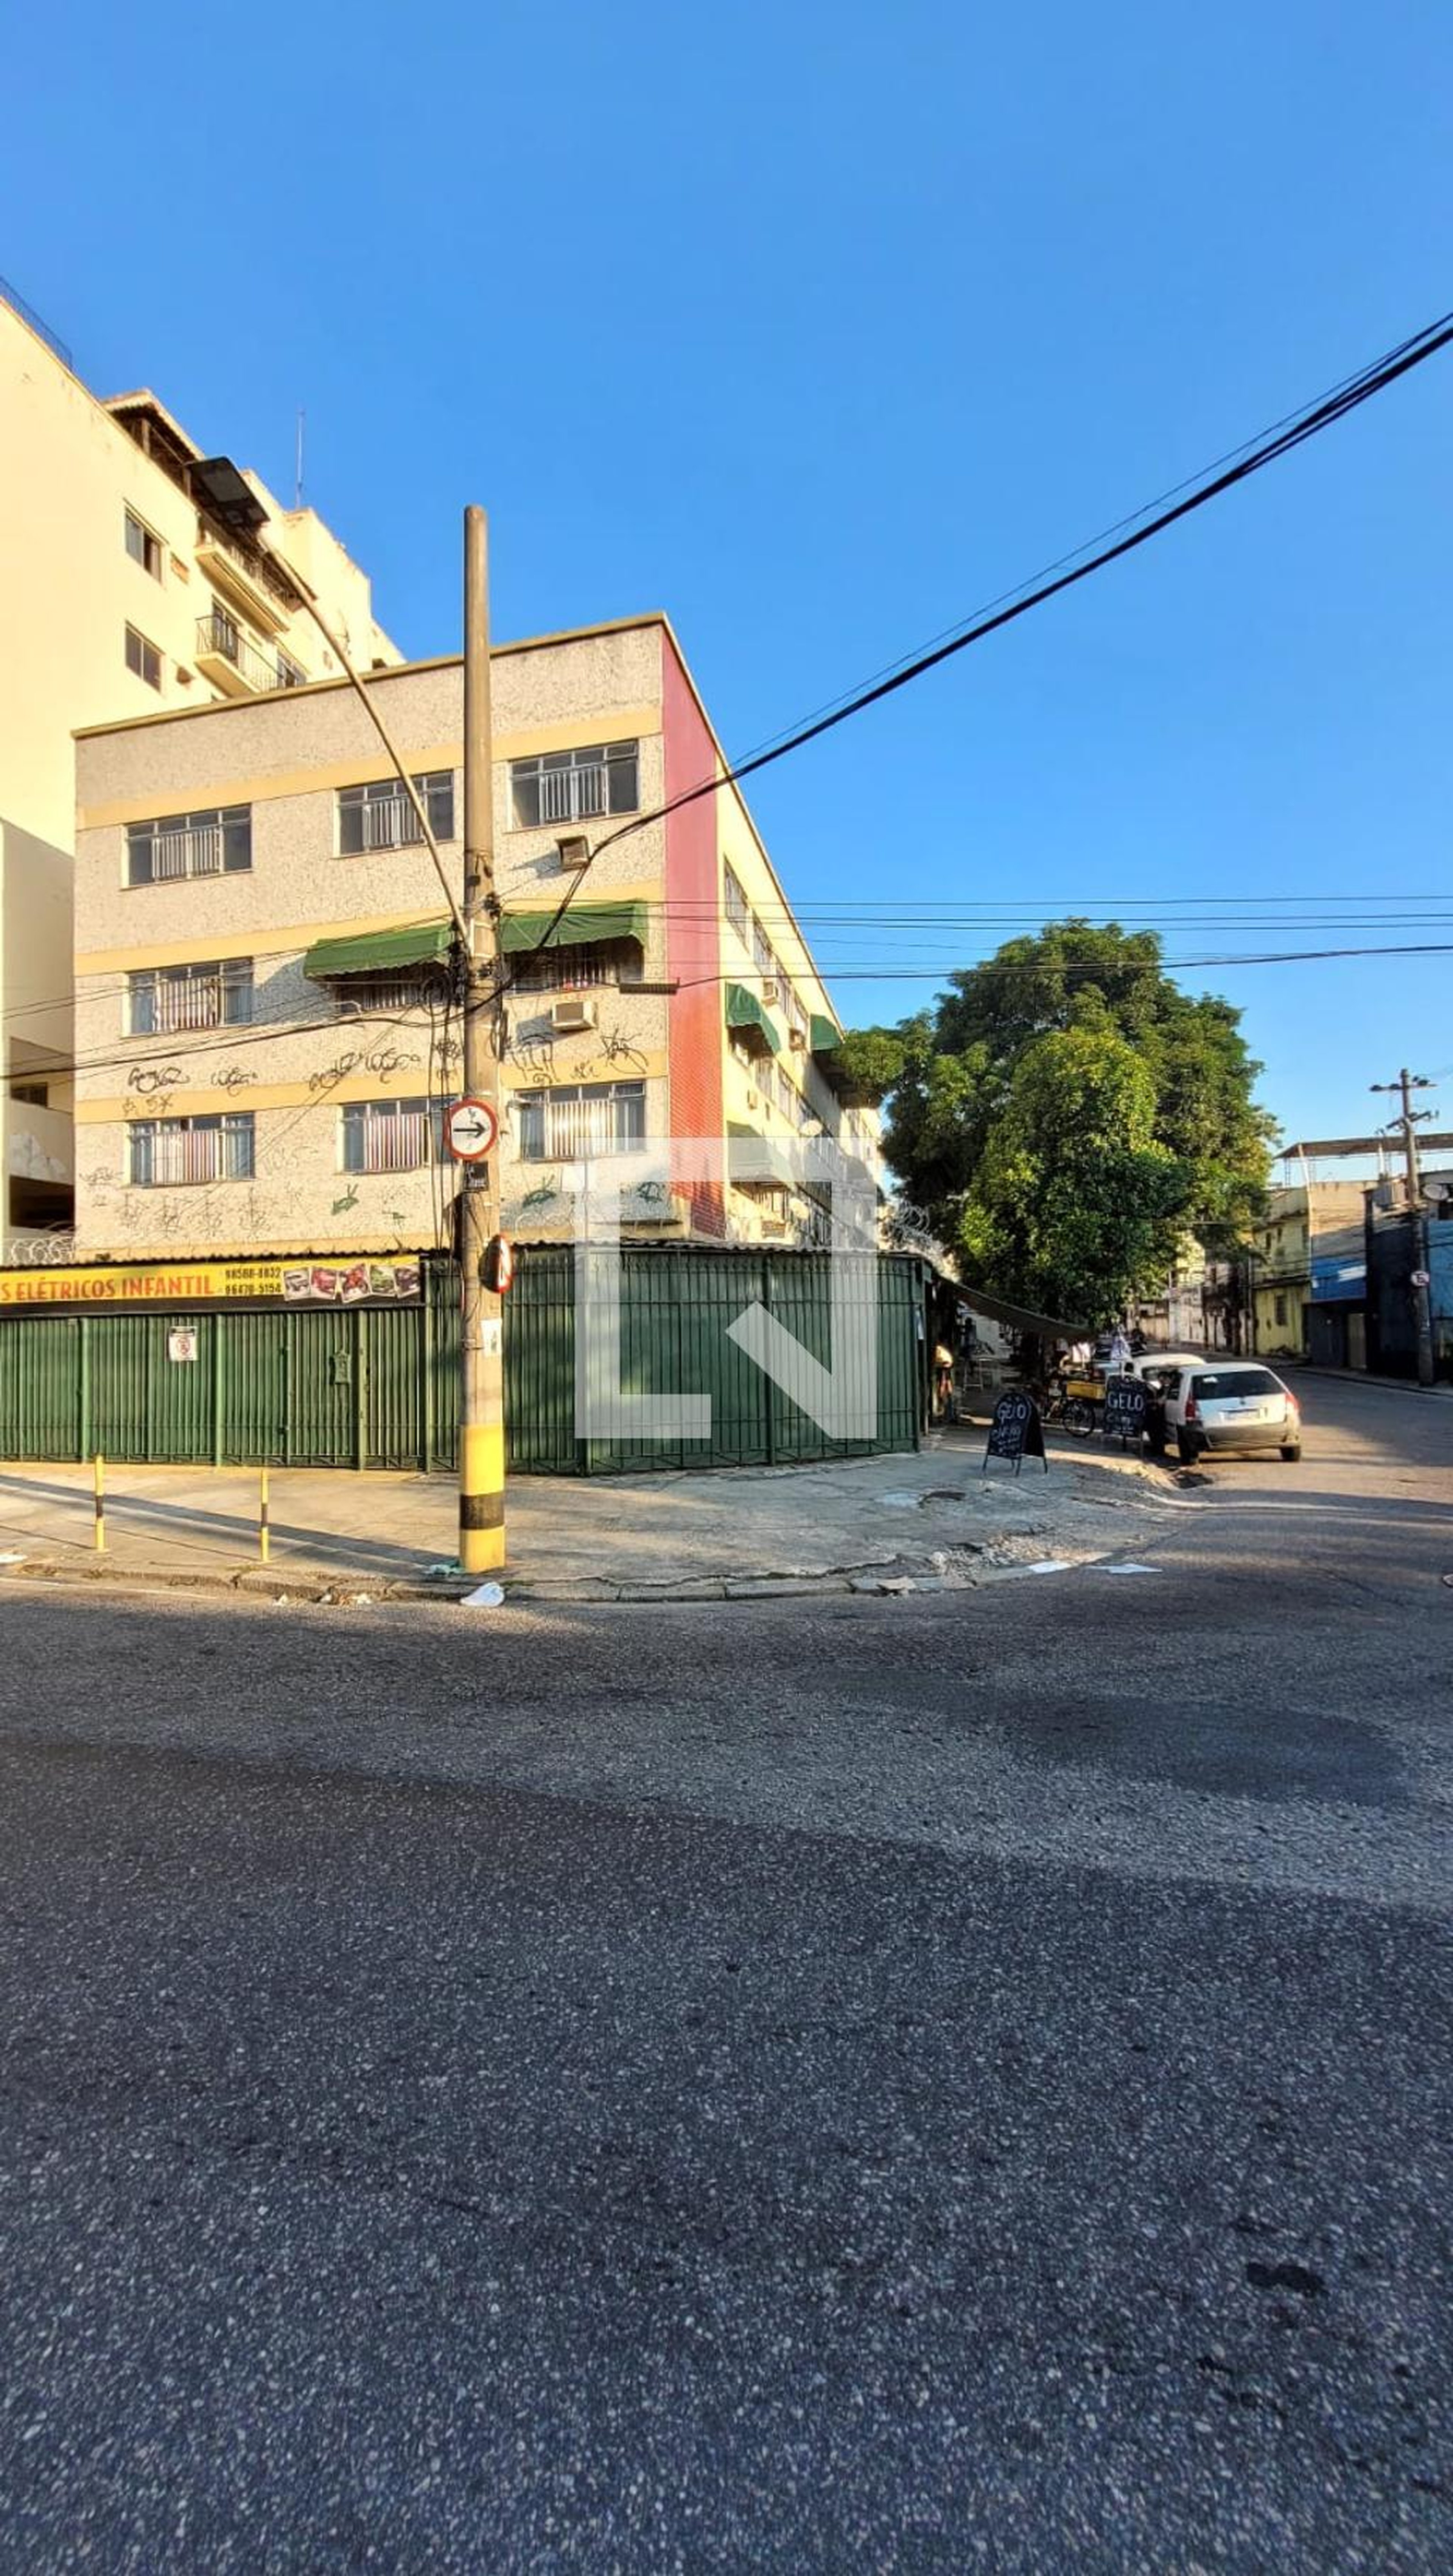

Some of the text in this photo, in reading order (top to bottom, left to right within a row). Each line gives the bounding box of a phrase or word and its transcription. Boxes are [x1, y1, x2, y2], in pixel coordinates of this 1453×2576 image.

[16, 1277, 115, 1300] ELÉTRICOS
[123, 1275, 214, 1296] INFANTIL
[1108, 1391, 1143, 1411] GELO
